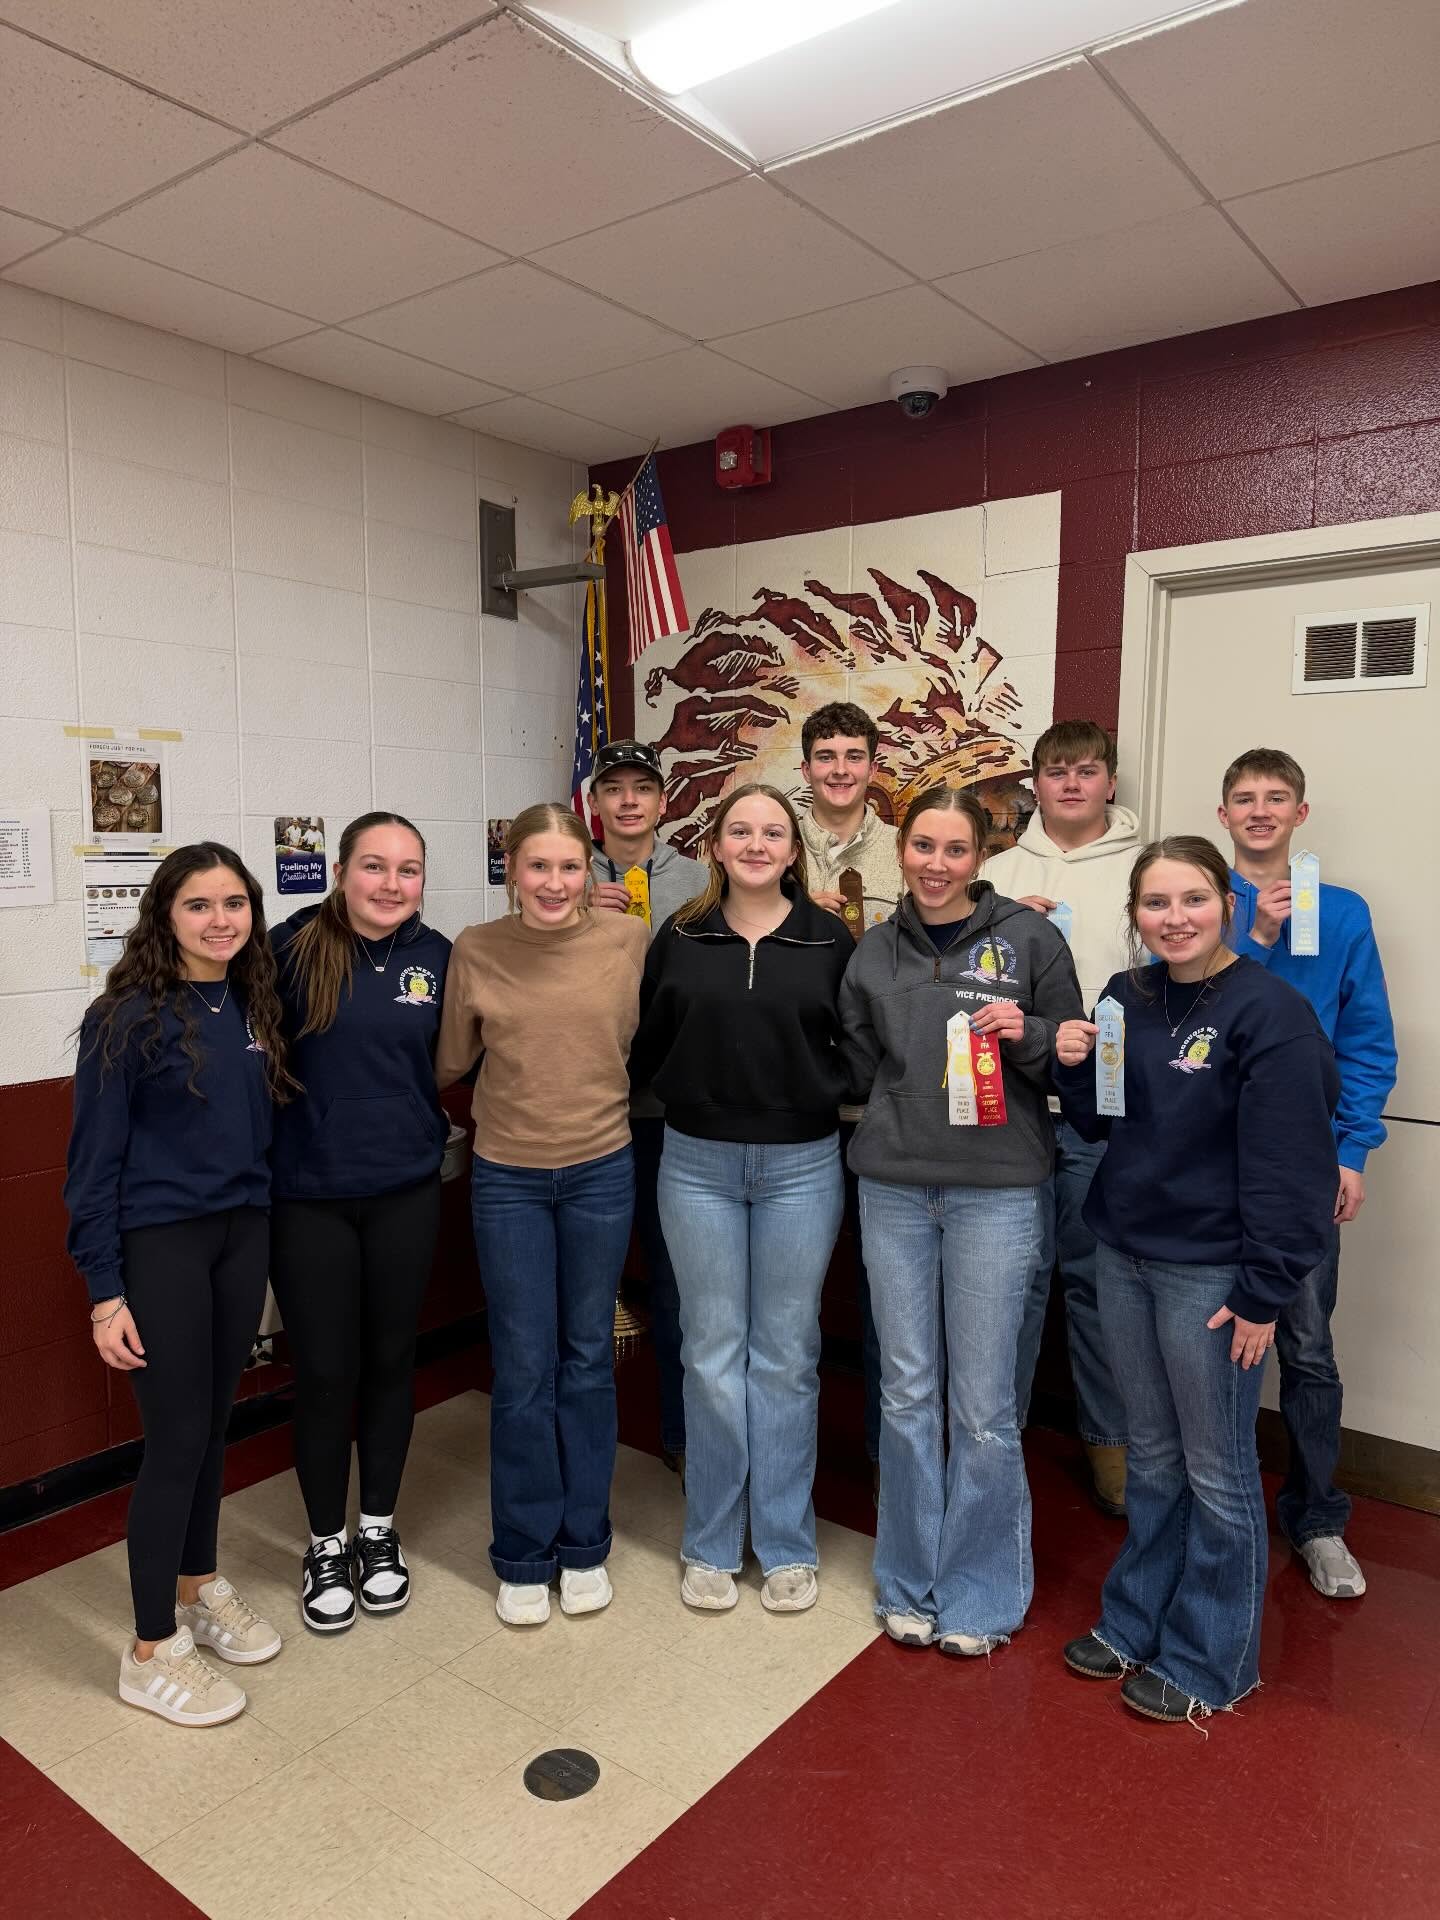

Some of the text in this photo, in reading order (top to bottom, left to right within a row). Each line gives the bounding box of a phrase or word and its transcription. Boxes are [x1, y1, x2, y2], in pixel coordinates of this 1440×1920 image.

[280, 862, 322, 872] Fueling My
[281, 872, 322, 883] Creative Life
[955, 990, 975, 999] VICE
